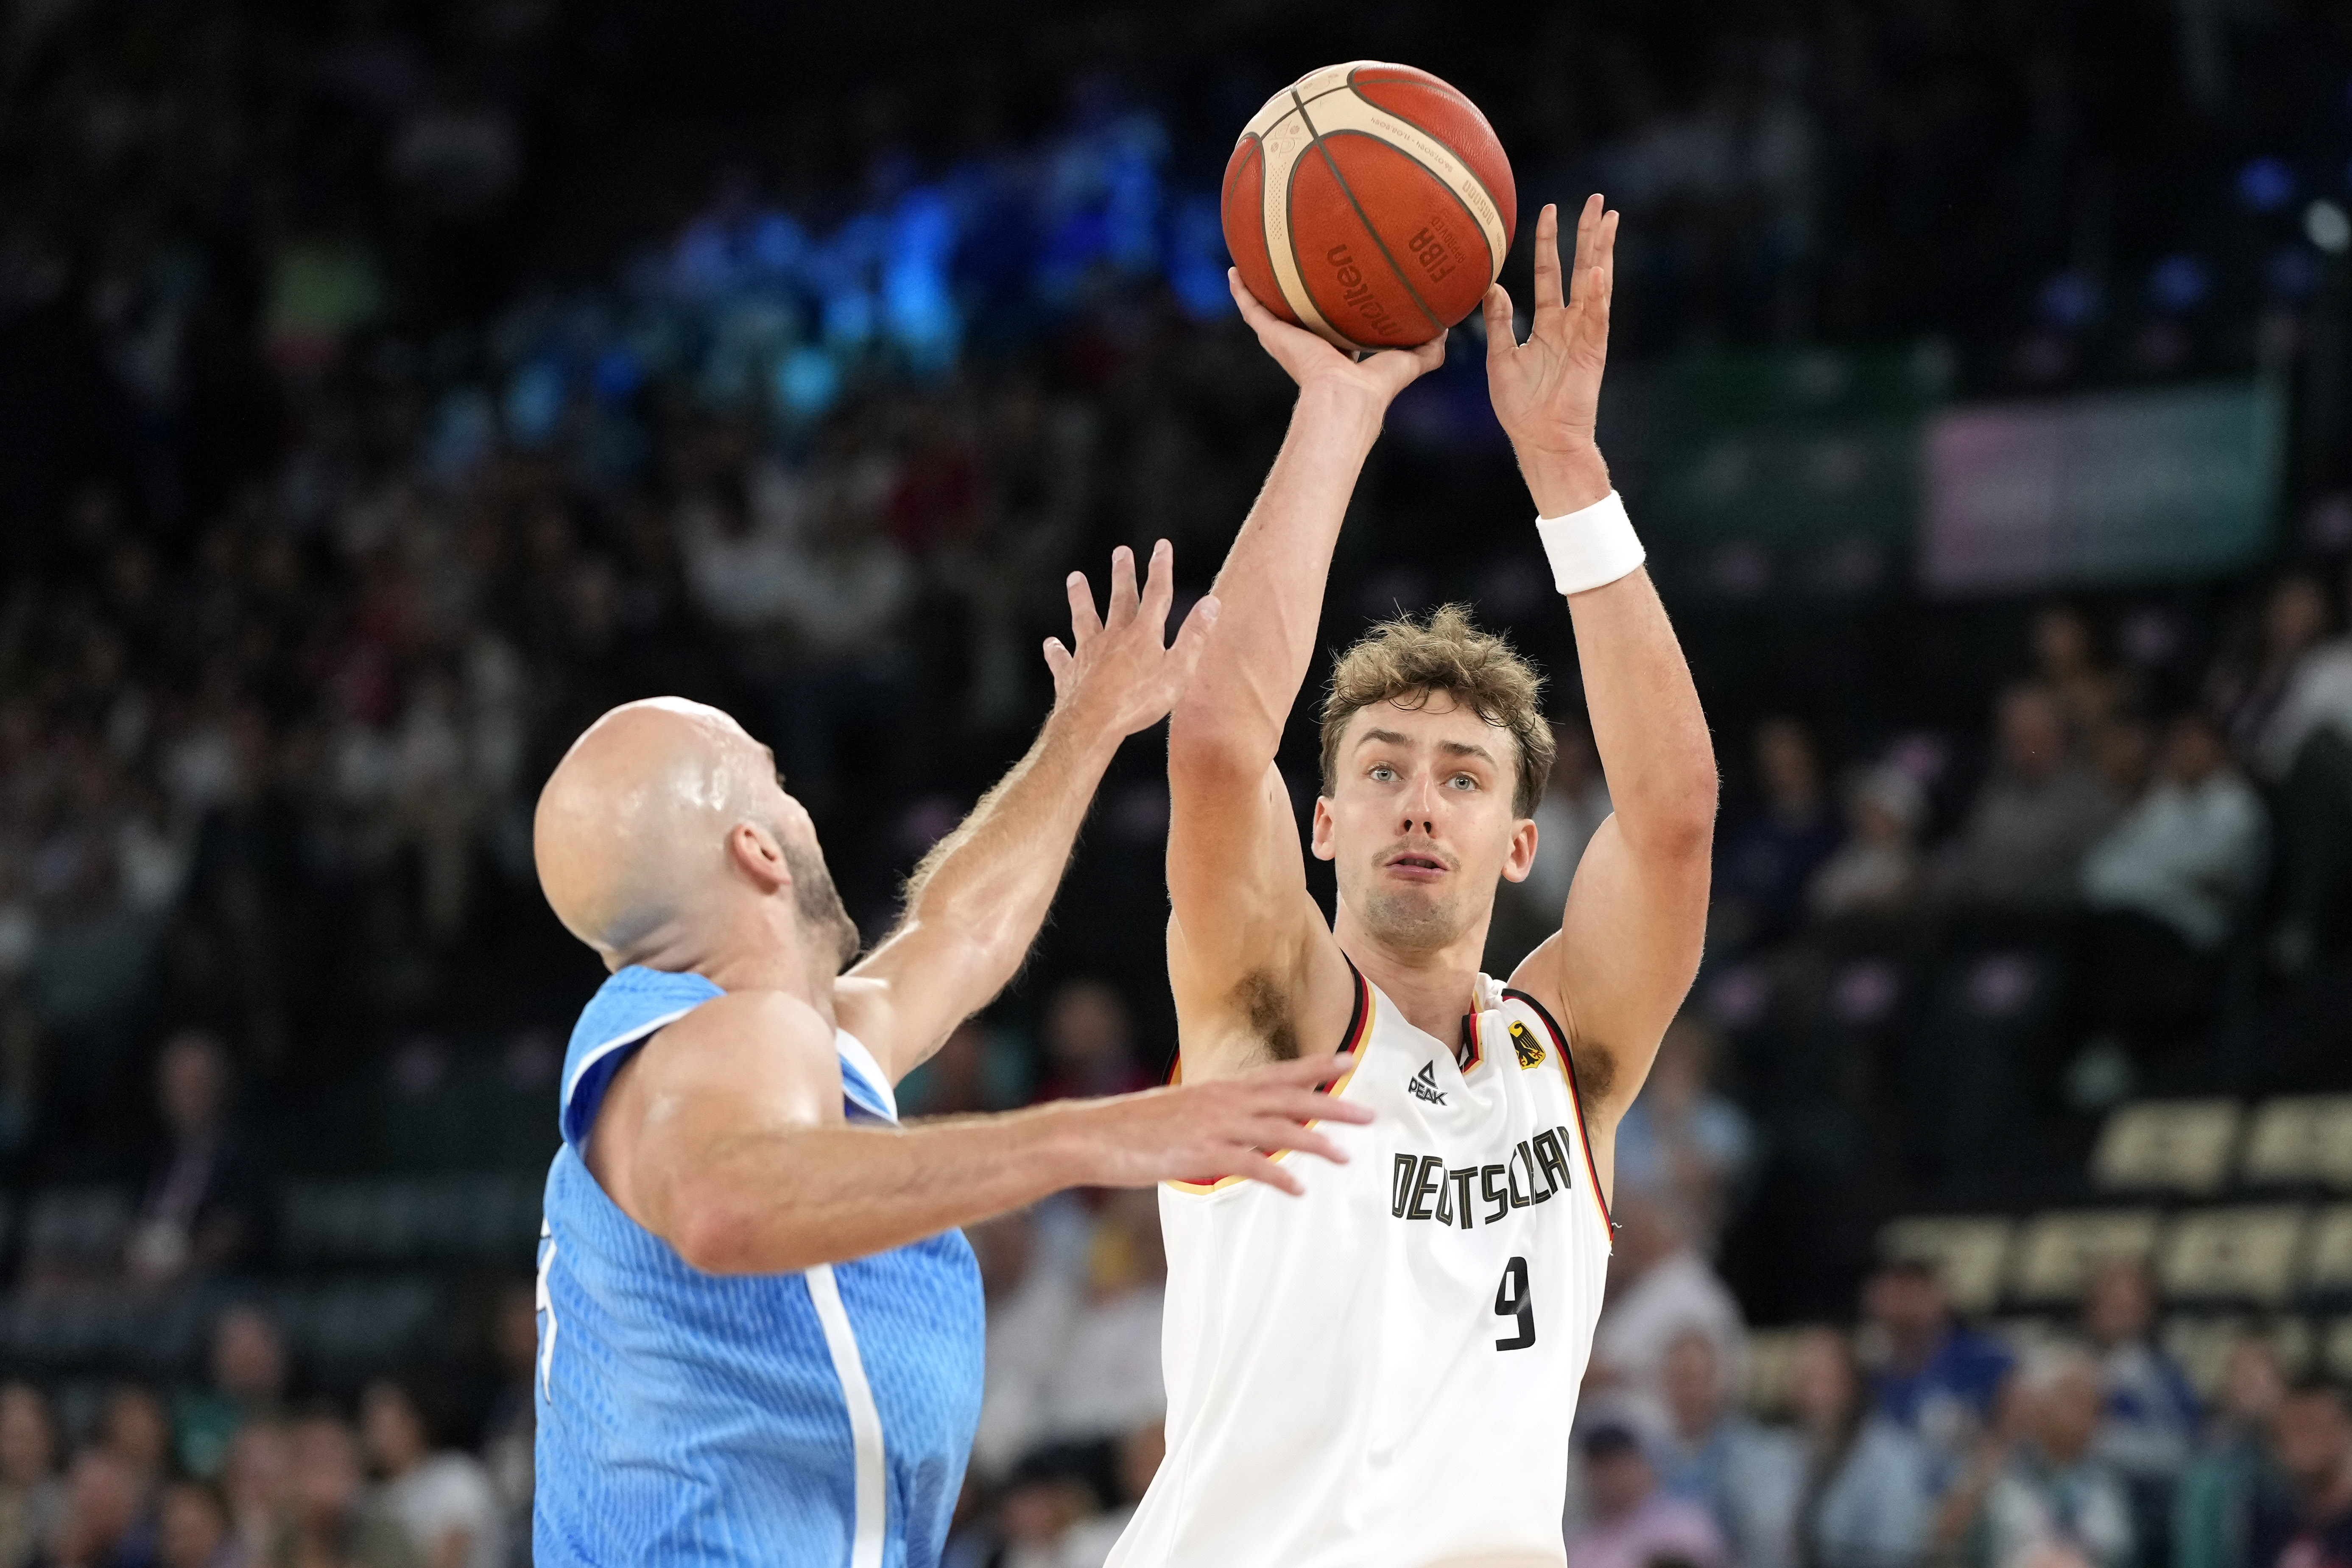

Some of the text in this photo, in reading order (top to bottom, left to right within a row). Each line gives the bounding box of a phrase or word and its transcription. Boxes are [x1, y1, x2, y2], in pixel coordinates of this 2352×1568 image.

[1409, 227, 1456, 283] FIBA
[1431, 216, 1466, 263] APPROVED
[1327, 244, 1403, 336] molten
[1408, 1076, 1448, 1106] PEAK
[1392, 1126, 1571, 1230] DEUTSCA
[1495, 1257, 1536, 1352] 9
